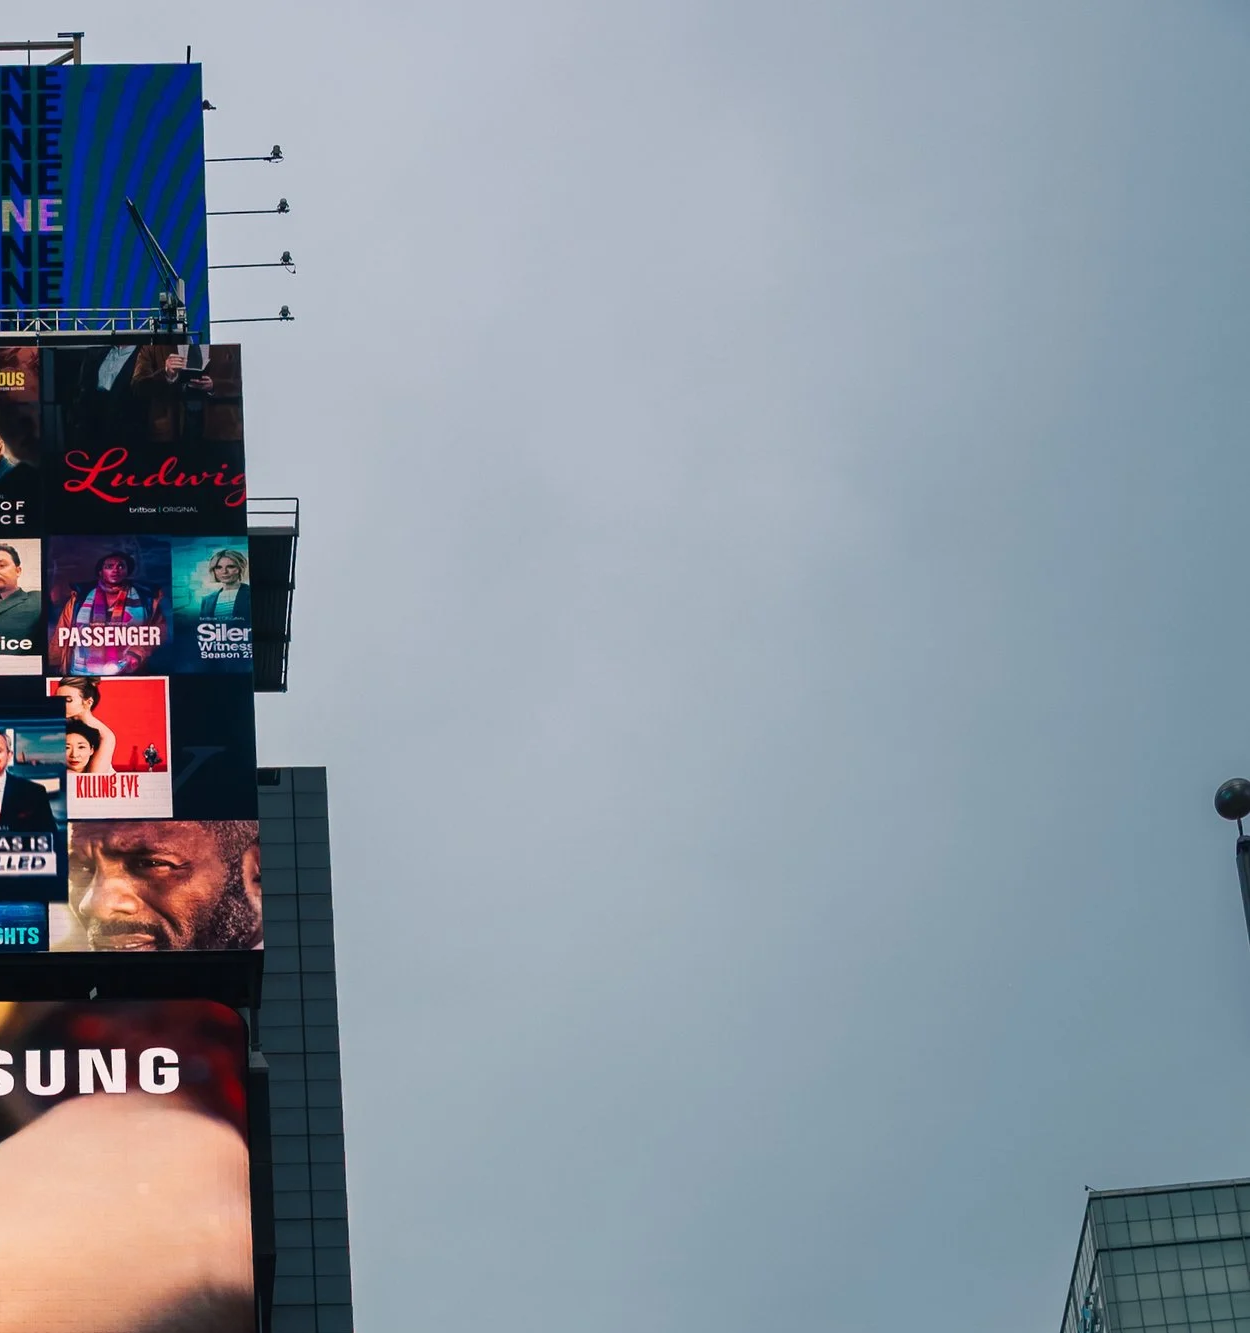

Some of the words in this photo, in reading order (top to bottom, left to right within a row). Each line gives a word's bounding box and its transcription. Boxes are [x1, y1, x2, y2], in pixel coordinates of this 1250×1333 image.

[63, 447, 247, 507] Ludwig
[0, 501, 25, 511] OF
[58, 626, 160, 647] PASSENGER
[201, 651, 240, 659] Season
[76, 773, 117, 798] KILLING
[121, 774, 139, 799] EVE
[30, 836, 49, 850] IS
